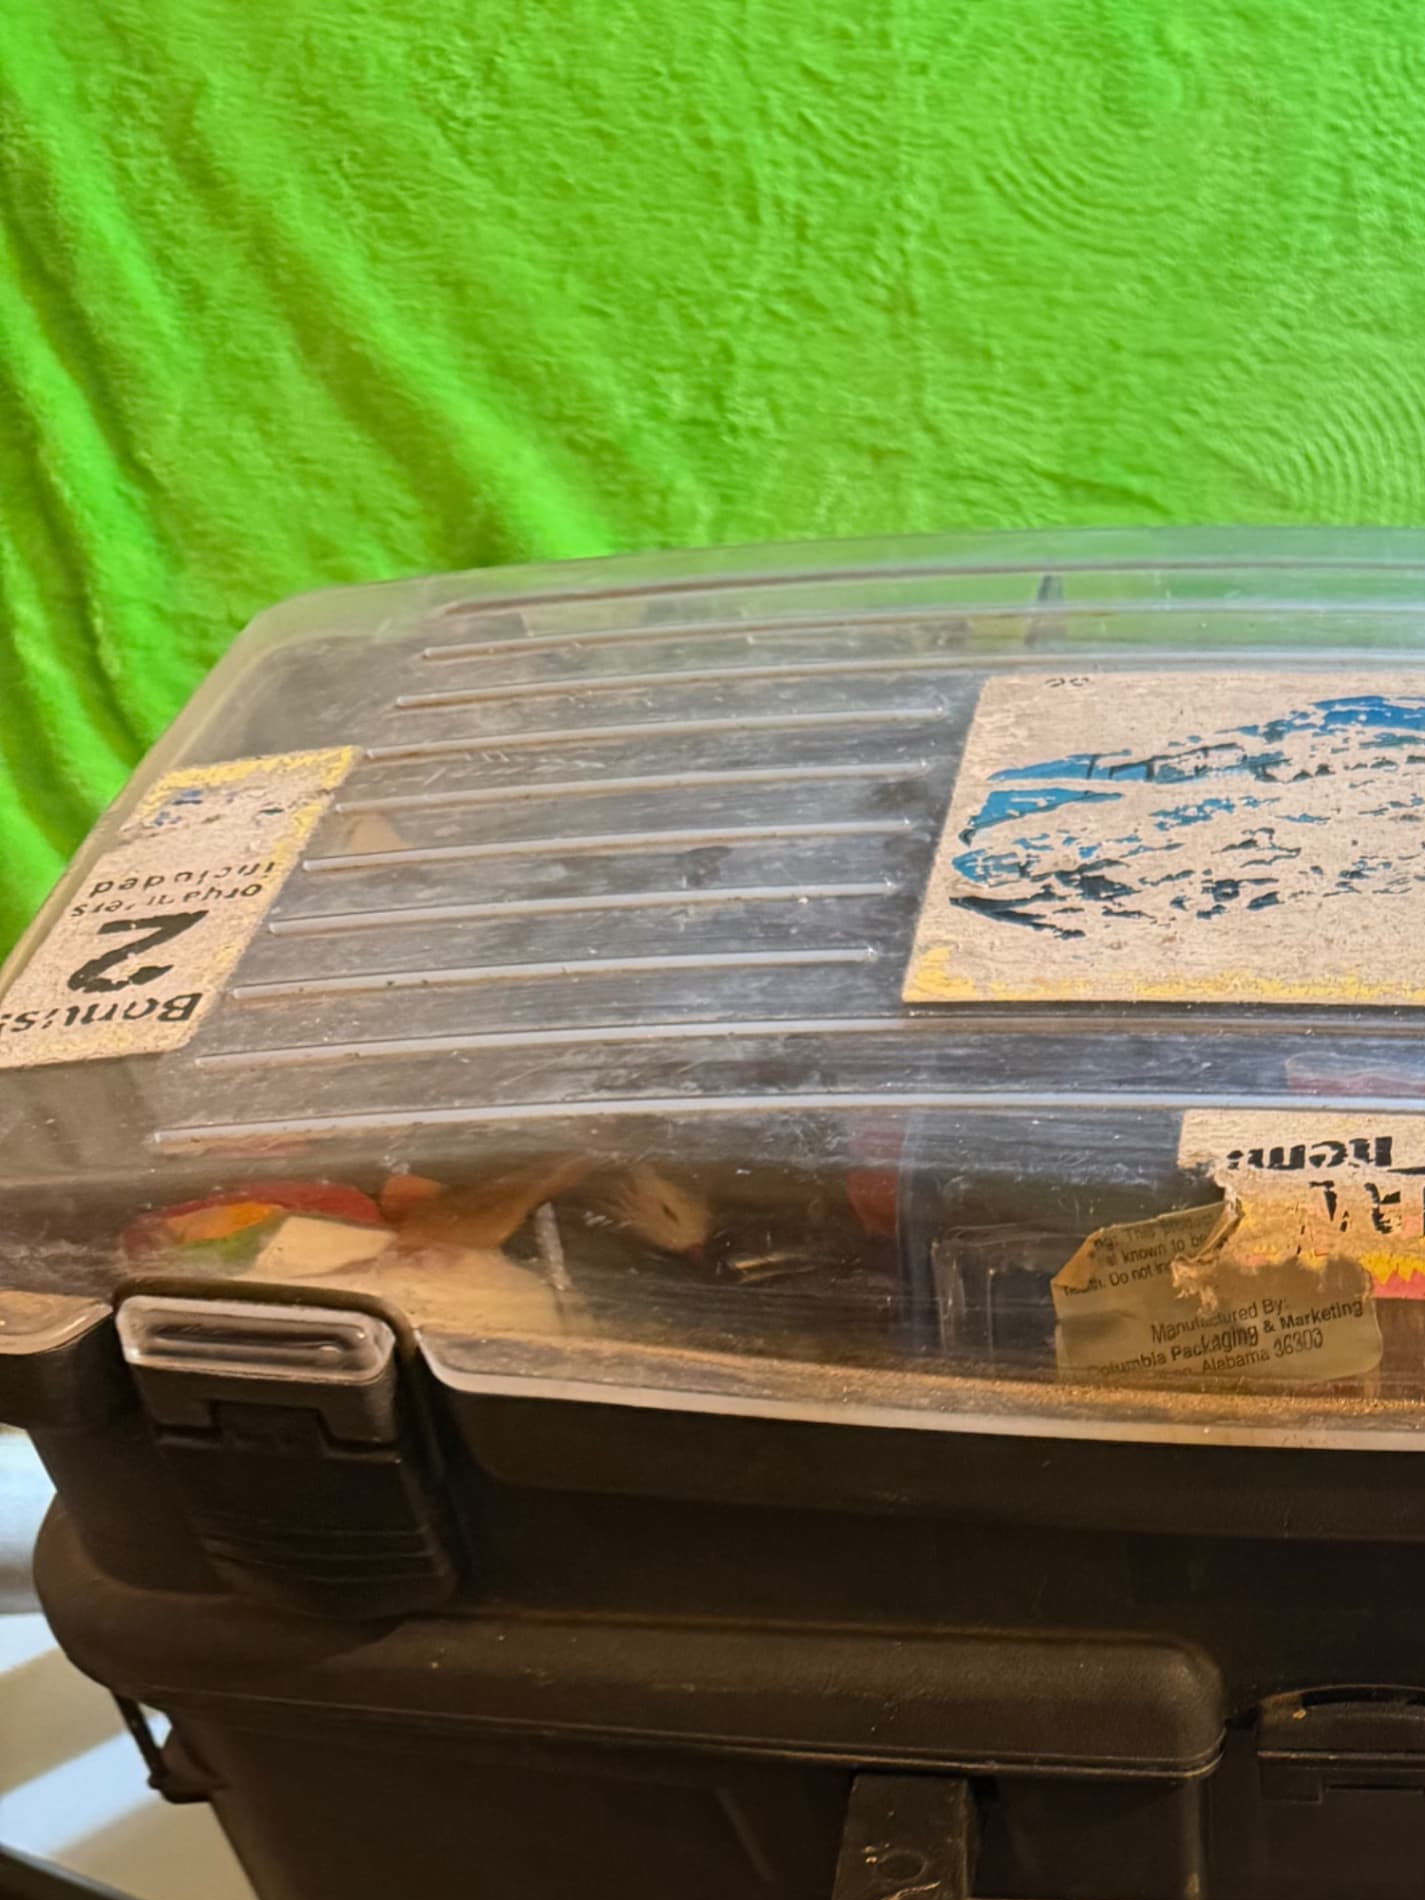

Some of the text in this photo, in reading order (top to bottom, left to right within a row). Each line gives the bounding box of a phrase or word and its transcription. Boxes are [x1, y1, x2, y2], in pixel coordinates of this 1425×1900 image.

[89, 862, 276, 898] included
[67, 911, 209, 994] 2
[1121, 1242, 1168, 1264] known
[1171, 1238, 1186, 1253] to
[1132, 1264, 1153, 1281] not
[1263, 1296, 1289, 1318] By:
[1171, 1324, 1260, 1362] Packaging
[1263, 1318, 1276, 1333] &
[1280, 1299, 1364, 1329] Marketing
[1202, 1348, 1271, 1373] Alabama
